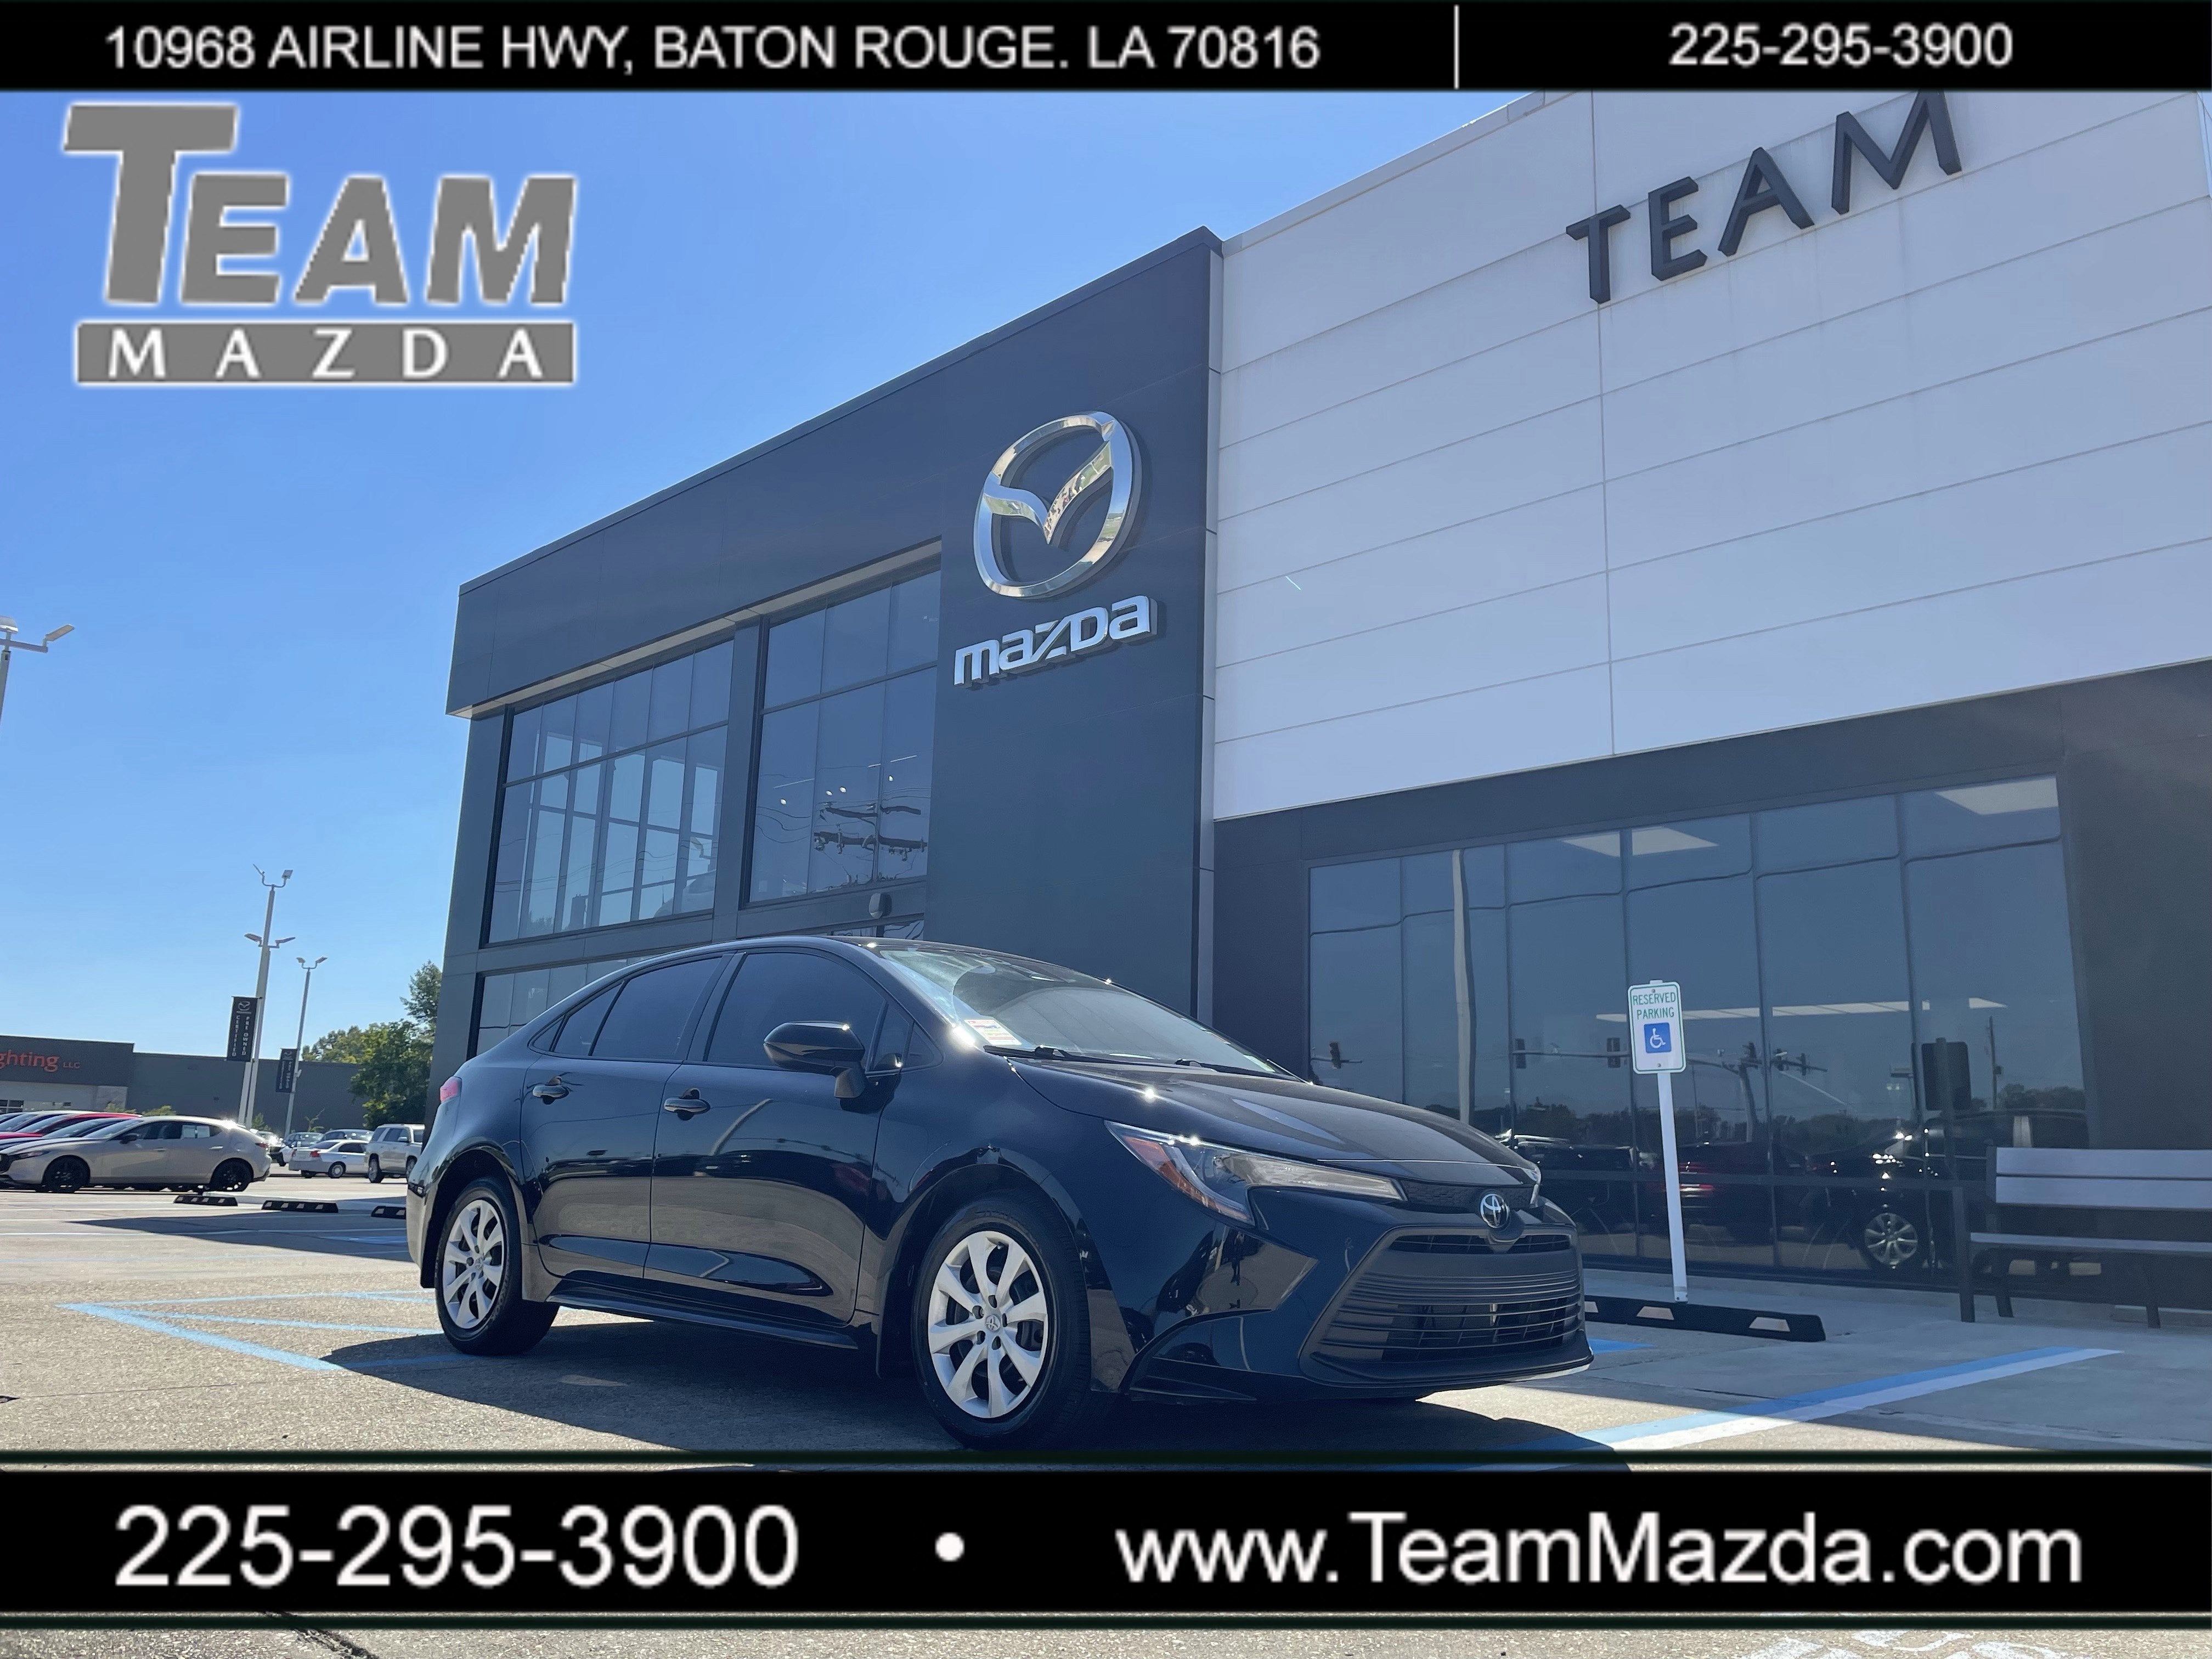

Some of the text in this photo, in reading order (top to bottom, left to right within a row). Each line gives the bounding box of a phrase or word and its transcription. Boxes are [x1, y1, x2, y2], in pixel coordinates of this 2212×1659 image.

[1566, 89, 1962, 304] TEAM
[1633, 992, 1676, 1006] RESERVED
[1637, 1007, 1674, 1019] PARKING
